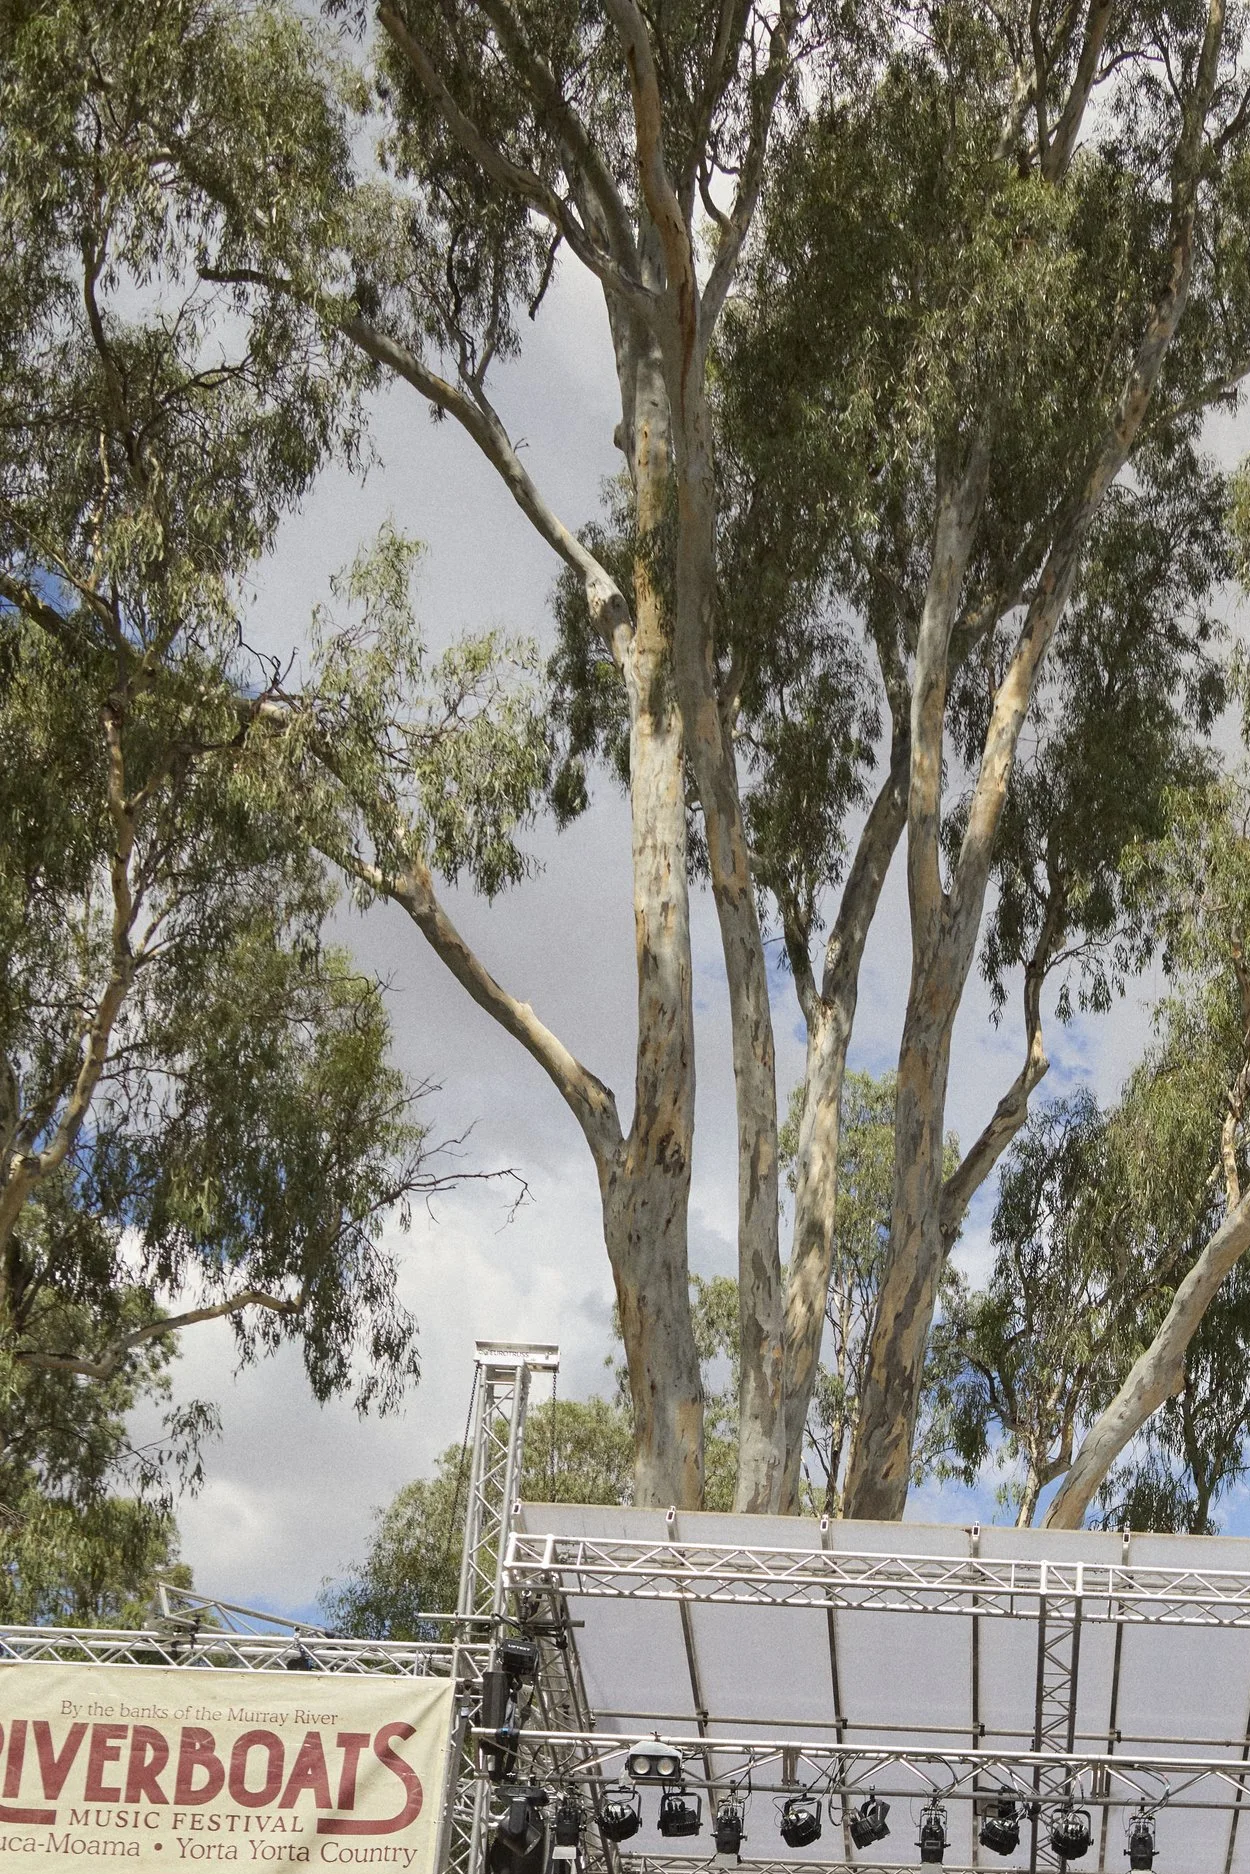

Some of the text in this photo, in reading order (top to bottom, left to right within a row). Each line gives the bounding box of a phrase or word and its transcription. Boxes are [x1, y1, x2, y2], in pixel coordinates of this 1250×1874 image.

[60, 1700, 338, 1726] By the banks of the Murray River
[0, 1719, 423, 1835] IVERBOATS
[69, 1808, 305, 1833] MUSIC FESTIVAL
[176, 1838, 238, 1860] Yorta
[249, 1839, 310, 1862] Yorta
[320, 1841, 417, 1868] Country
